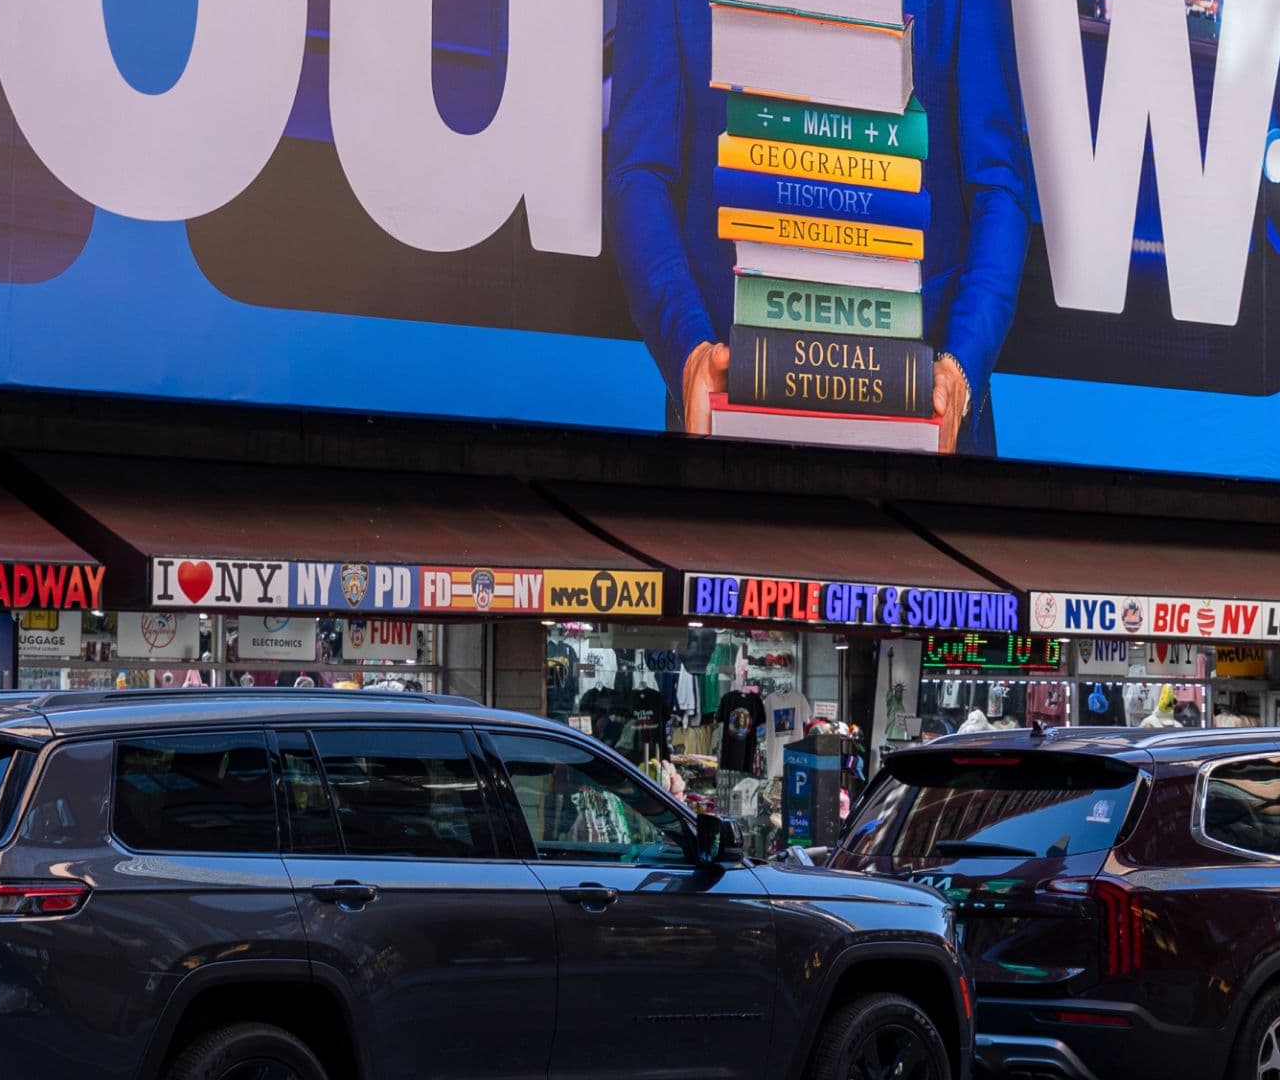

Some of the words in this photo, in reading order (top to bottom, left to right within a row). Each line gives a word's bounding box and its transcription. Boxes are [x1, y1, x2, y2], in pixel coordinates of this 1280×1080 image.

[803, 110, 853, 141] MATH
[749, 143, 892, 183] GEOGRAPHY
[776, 181, 874, 216] HISTORY
[778, 218, 870, 249] ENGLISH
[766, 290, 892, 330] SCIENCE
[794, 340, 881, 372] SOCIAL
[785, 371, 884, 404] STUDIES
[157, 560, 175, 601] I
[215, 561, 282, 603] NY
[296, 564, 333, 606] NY
[375, 565, 412, 608] PD
[423, 570, 452, 608] FD
[513, 573, 543, 610] NY
[551, 586, 589, 608] NYC
[590, 570, 658, 613] TAXI
[696, 575, 739, 617] BIG
[742, 578, 820, 621] APPLE
[825, 582, 877, 624] GIFT
[882, 587, 904, 626] &
[906, 587, 1020, 632] SOUVENIR
[1065, 597, 1116, 631] NYC
[1153, 602, 1192, 635] BIG
[1220, 604, 1260, 636] NY
[18, 635, 66, 647] UGGAGE
[252, 638, 303, 649] ELECTRONICS
[371, 619, 413, 646] FDNY
[795, 771, 808, 796] P
